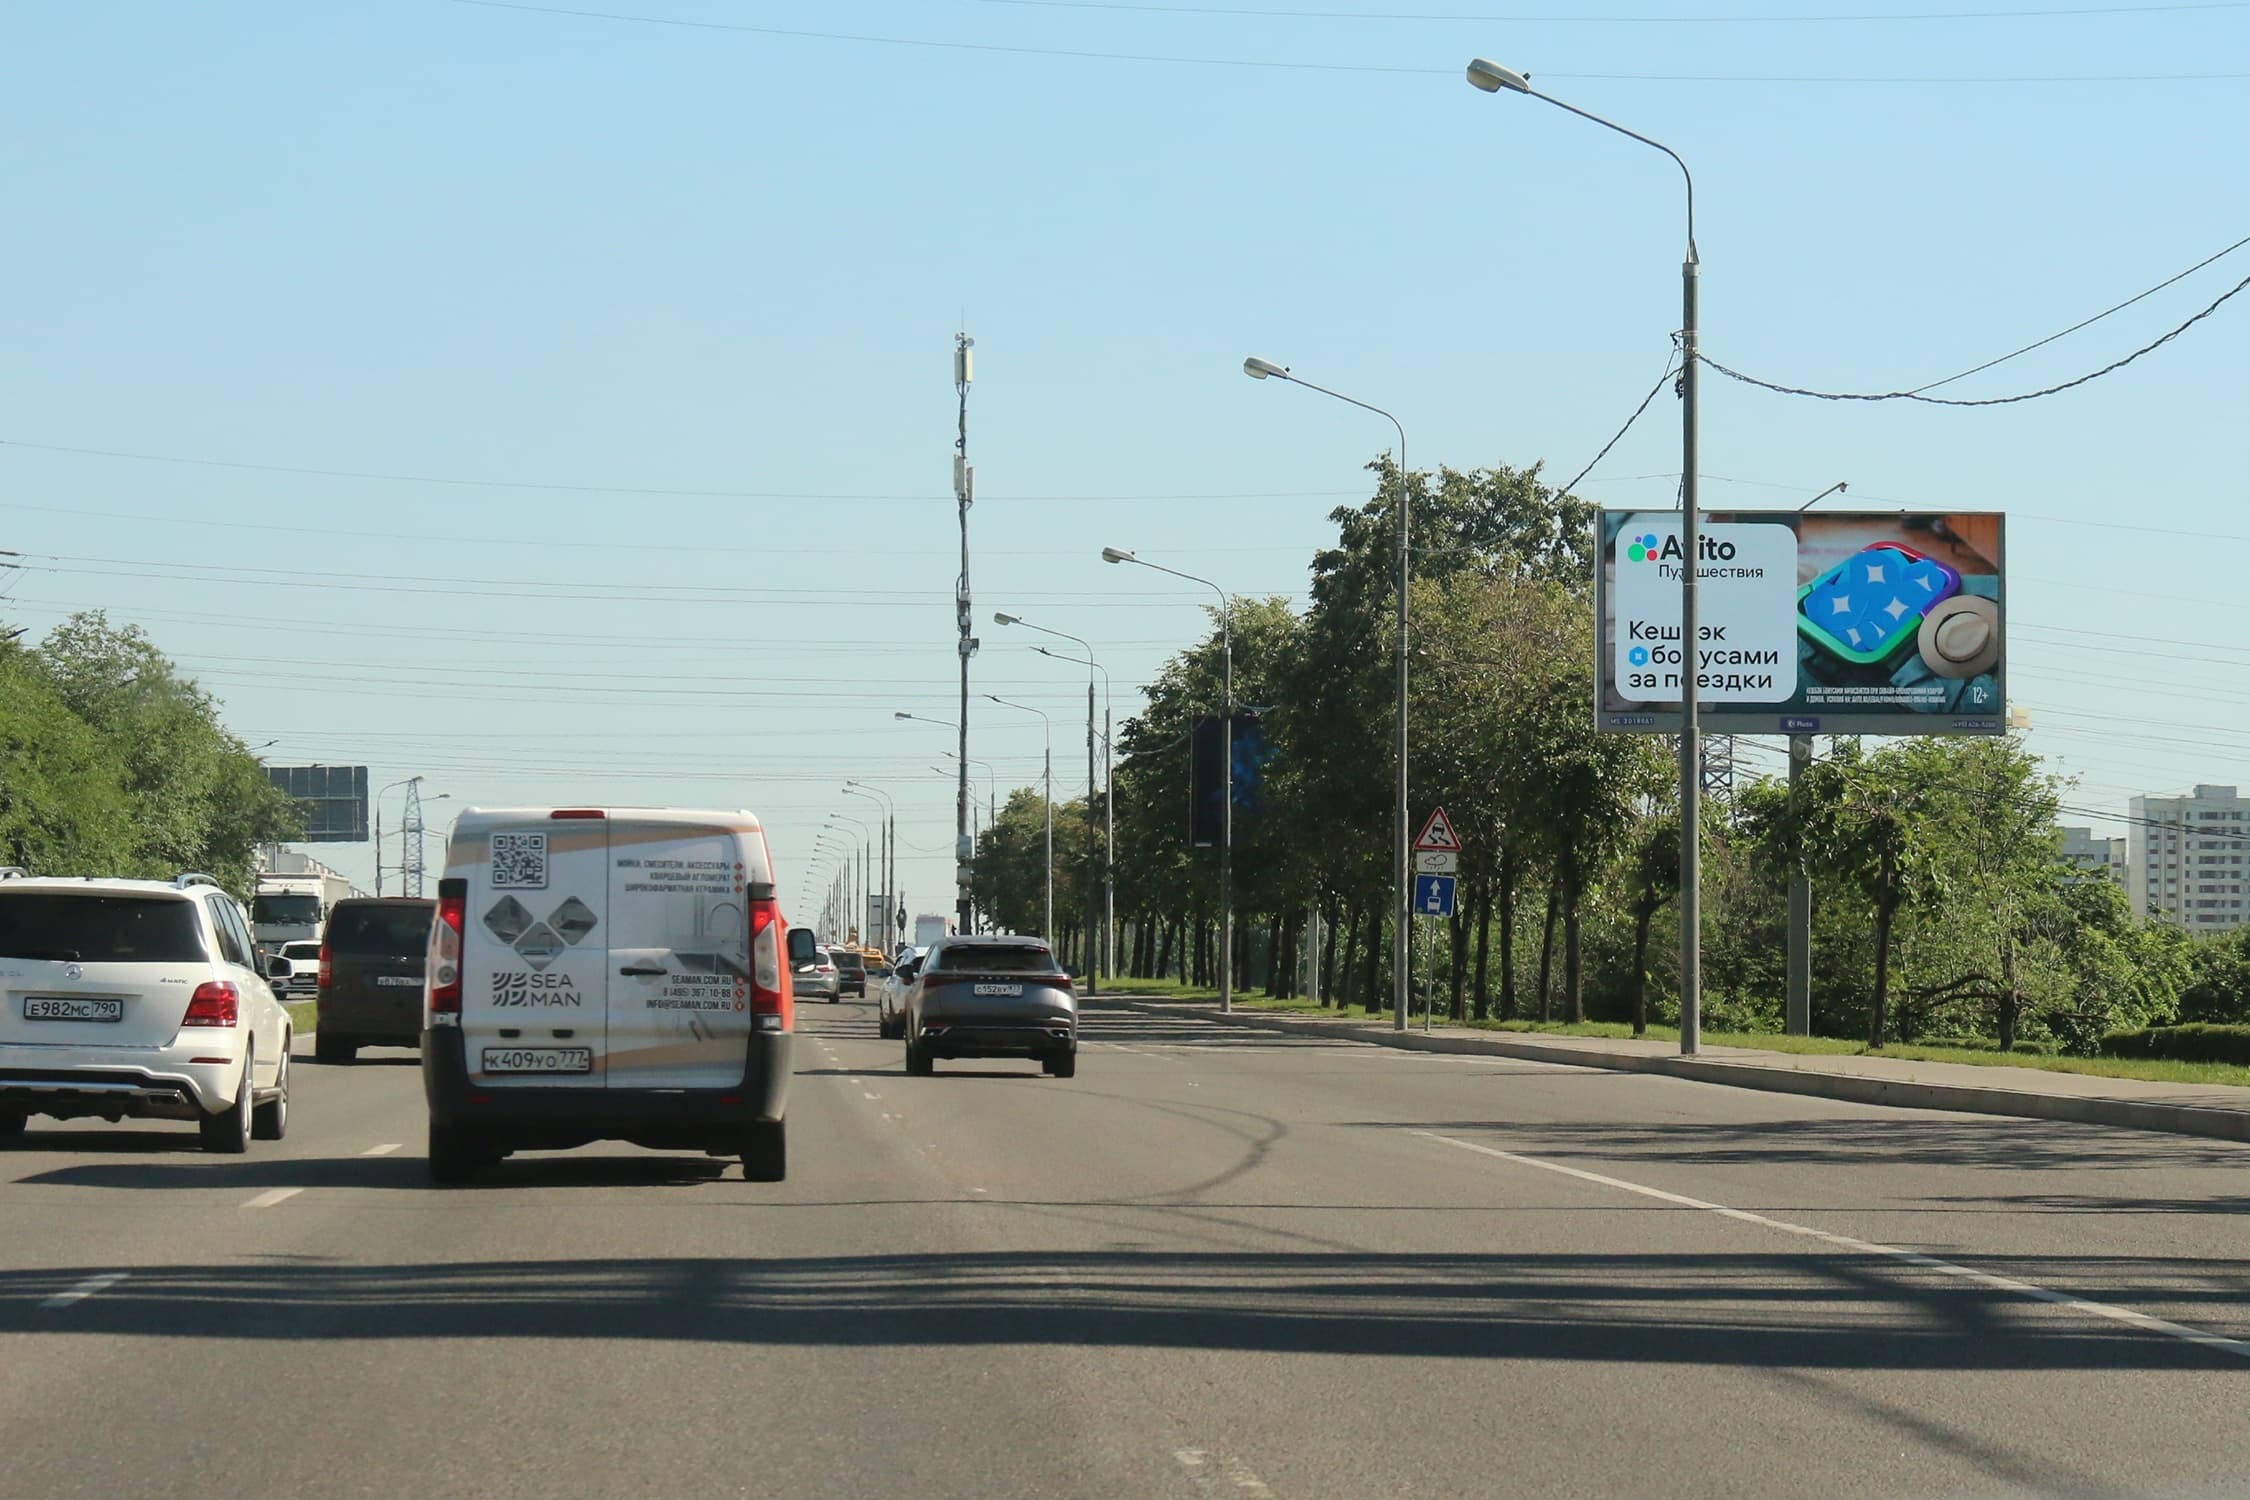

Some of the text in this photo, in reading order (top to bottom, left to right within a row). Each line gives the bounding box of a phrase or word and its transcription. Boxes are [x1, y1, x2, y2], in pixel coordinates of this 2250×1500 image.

[1659, 534, 1736, 561] Aito
[1659, 564, 1764, 580] Путшествия
[1629, 621, 1727, 641] Кешэк
[1652, 645, 1779, 670] боусами
[1629, 673, 1772, 692] за пездки
[1973, 686, 1990, 704] 12+
[530, 973, 574, 989] SEA
[530, 991, 582, 1007] MAN
